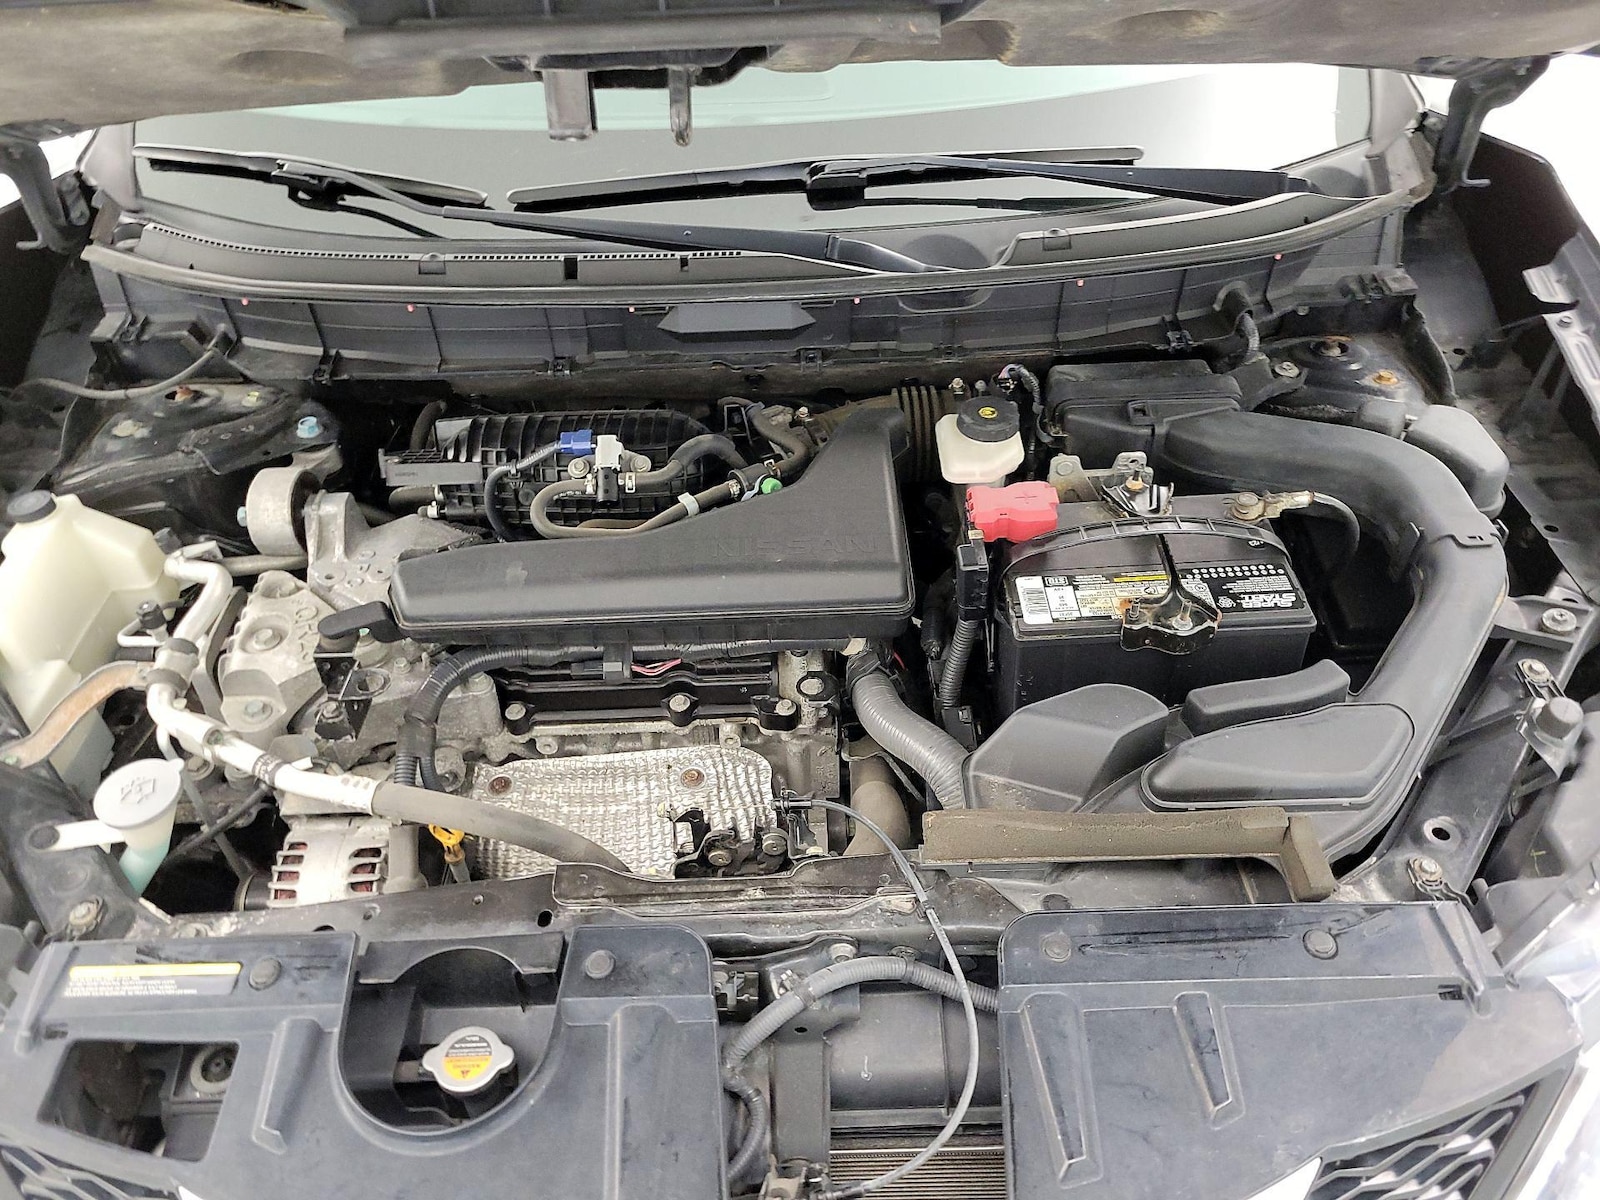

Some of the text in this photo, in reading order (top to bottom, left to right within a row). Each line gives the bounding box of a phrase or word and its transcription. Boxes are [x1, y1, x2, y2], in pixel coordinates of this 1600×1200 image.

[712, 535, 876, 557] NISSAN
[1240, 593, 1296, 602] START
[1242, 600, 1292, 608] SUPER
